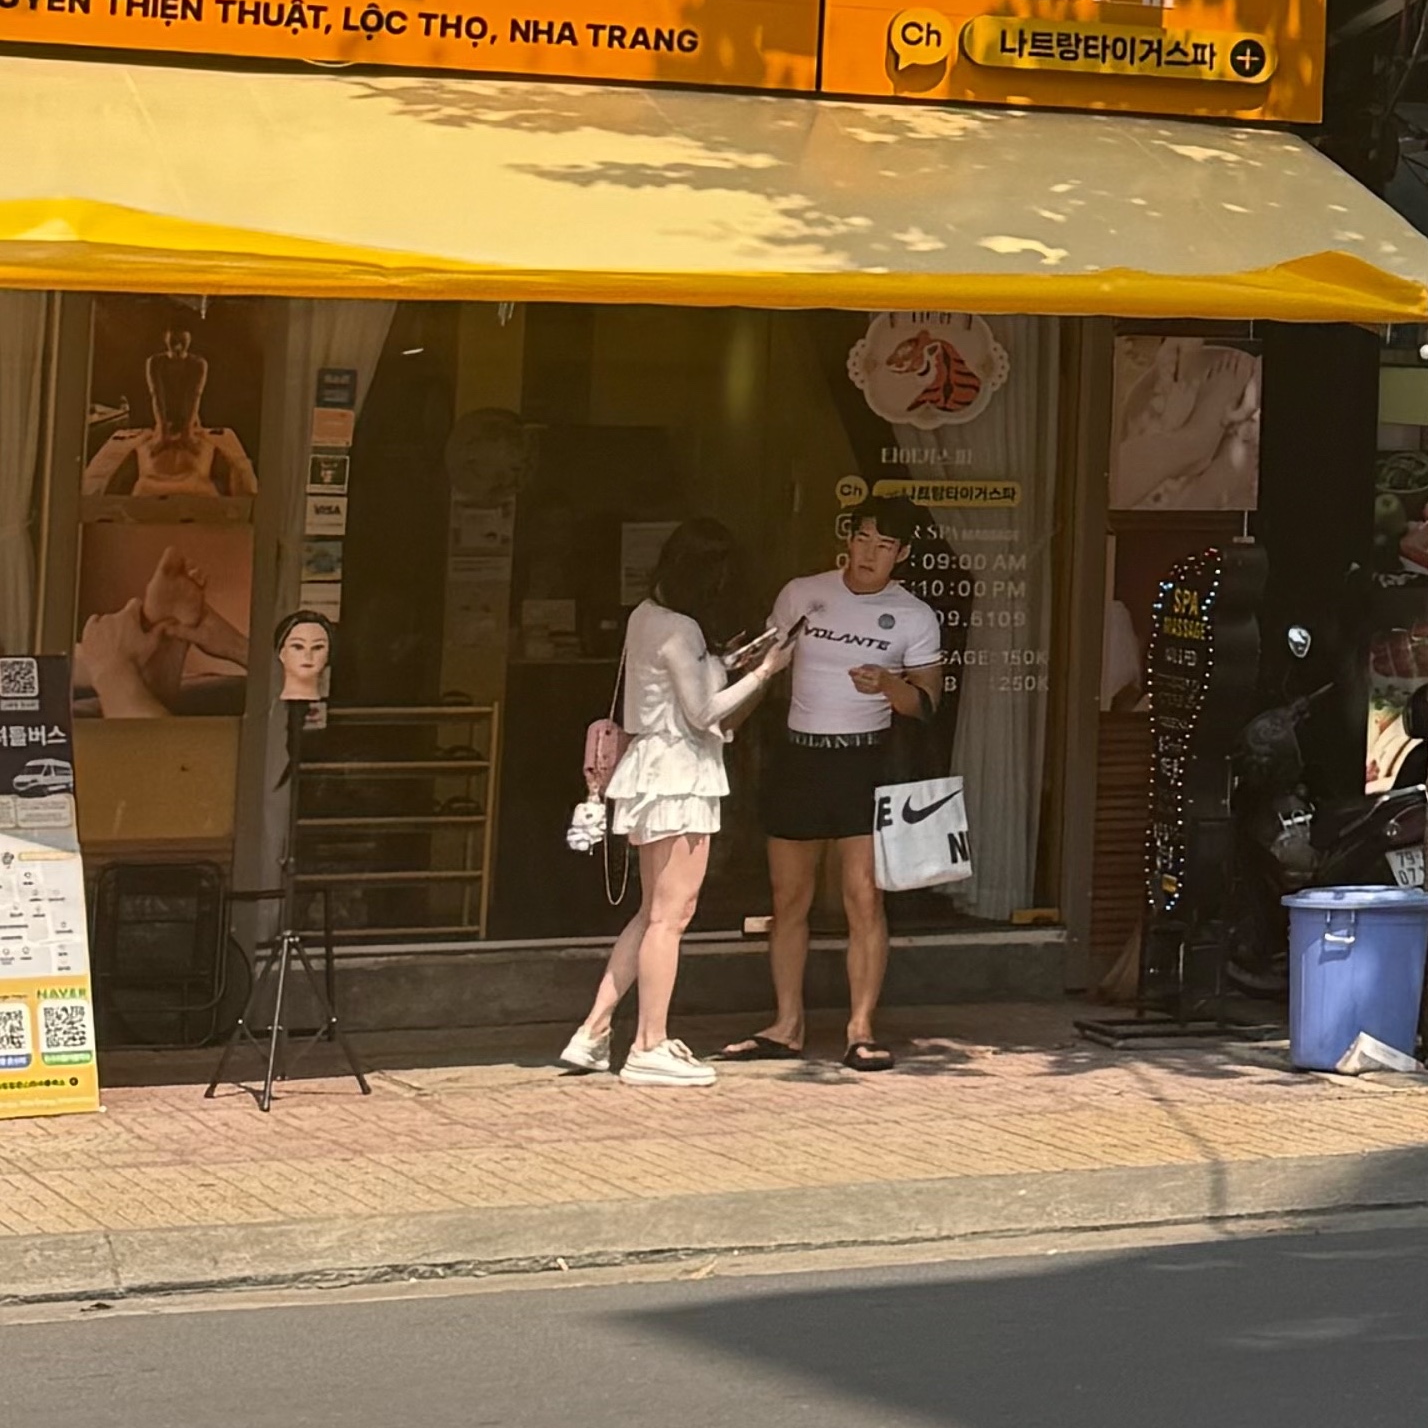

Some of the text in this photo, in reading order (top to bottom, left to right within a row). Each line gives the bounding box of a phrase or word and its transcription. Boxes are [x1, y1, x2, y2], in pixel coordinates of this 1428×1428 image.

[342, 2, 408, 39] LỘC
[419, 12, 498, 49] THỌ,
[509, 18, 578, 47] NHA
[587, 23, 699, 55] TRANG
[900, 21, 942, 50] Ch
[999, 27, 1218, 71] 나트랑타이거스파
[839, 483, 863, 497] Ch
[922, 552, 1027, 571] 09:00 AM
[992, 580, 1026, 598] PM
[1172, 587, 1200, 616] SPA
